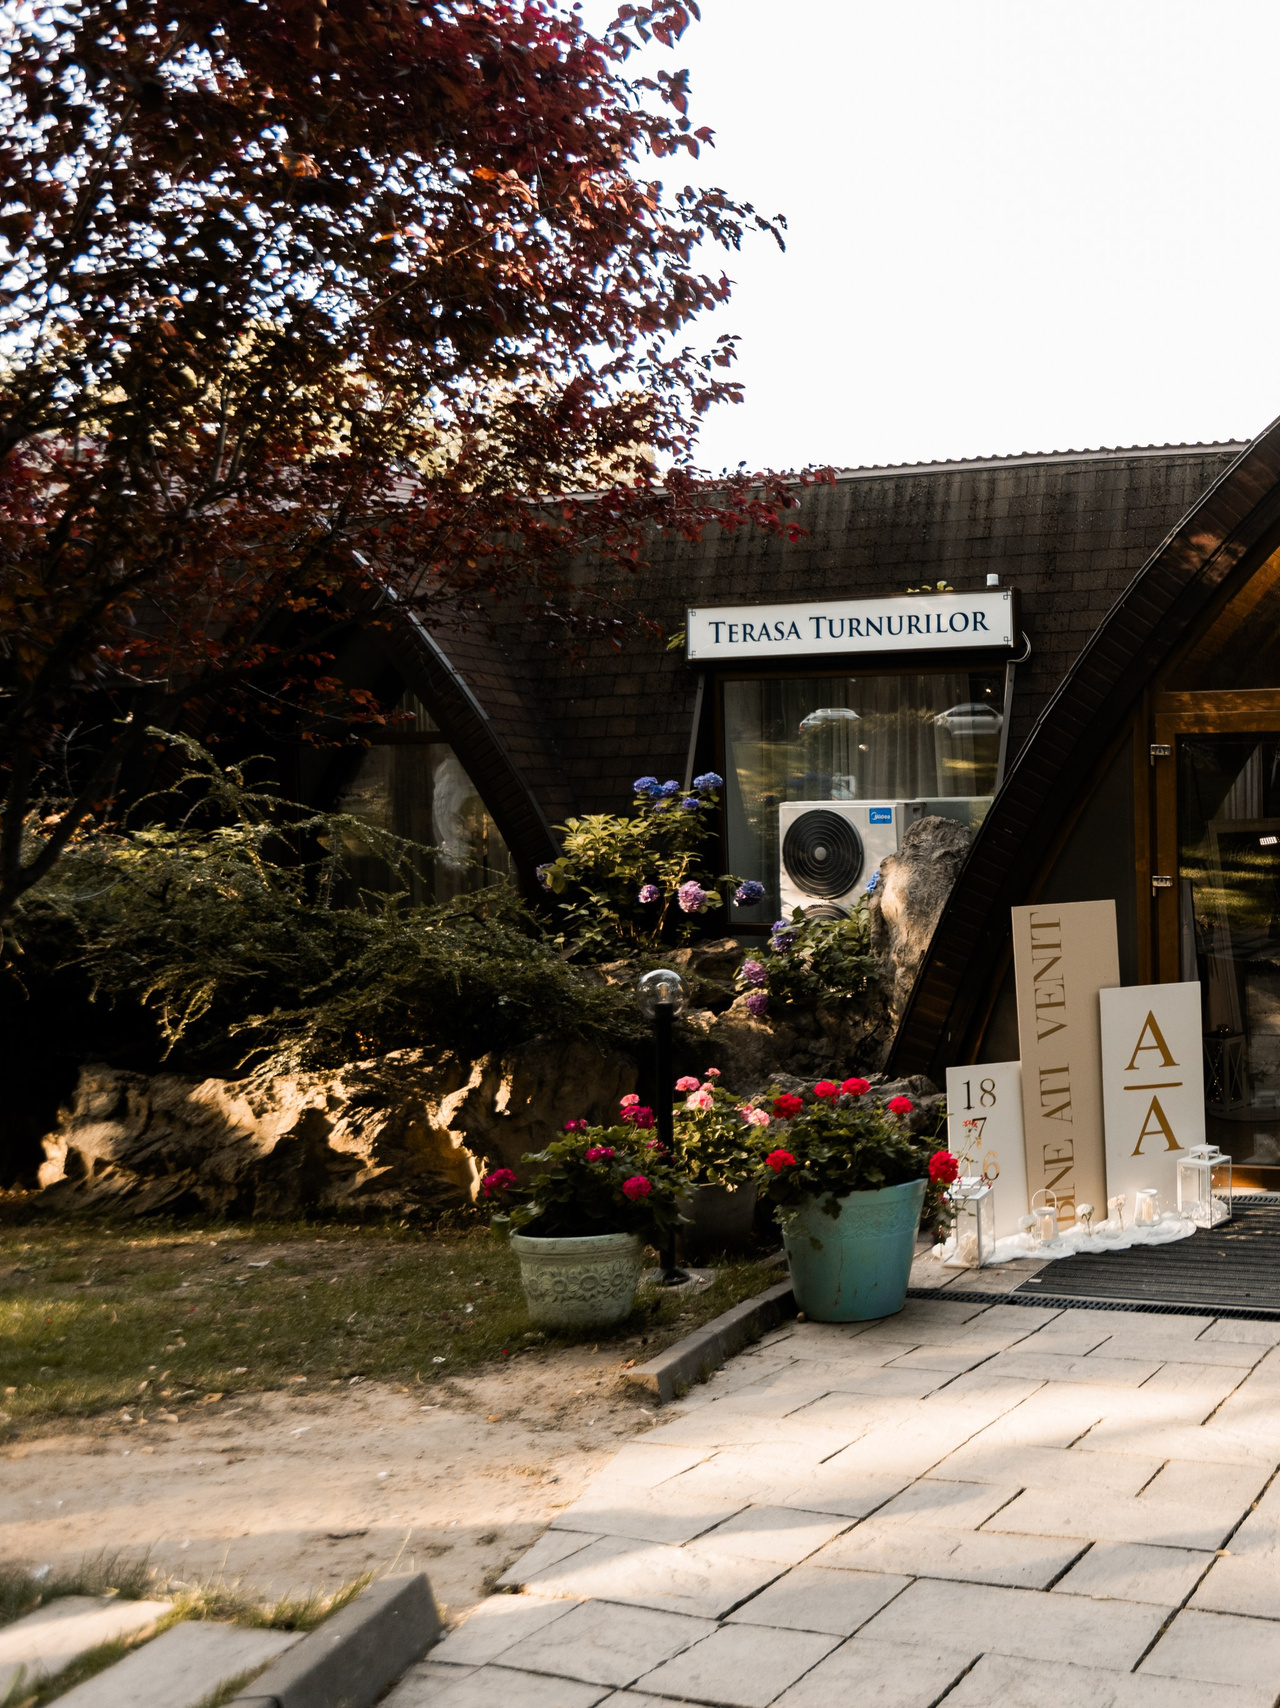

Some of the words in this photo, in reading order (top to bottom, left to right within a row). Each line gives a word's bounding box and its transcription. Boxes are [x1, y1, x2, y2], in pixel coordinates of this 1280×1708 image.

[709, 620, 803, 644] TERASA
[809, 610, 991, 639] TURNURILOR
[1029, 911, 1069, 1044] VENIT
[1124, 1010, 1181, 1071] A
[962, 1078, 997, 1111] 18
[1039, 1062, 1073, 1126] ATI
[972, 1116, 987, 1148] 7
[1131, 1094, 1185, 1157] A
[1043, 1138, 1076, 1227] BINE
